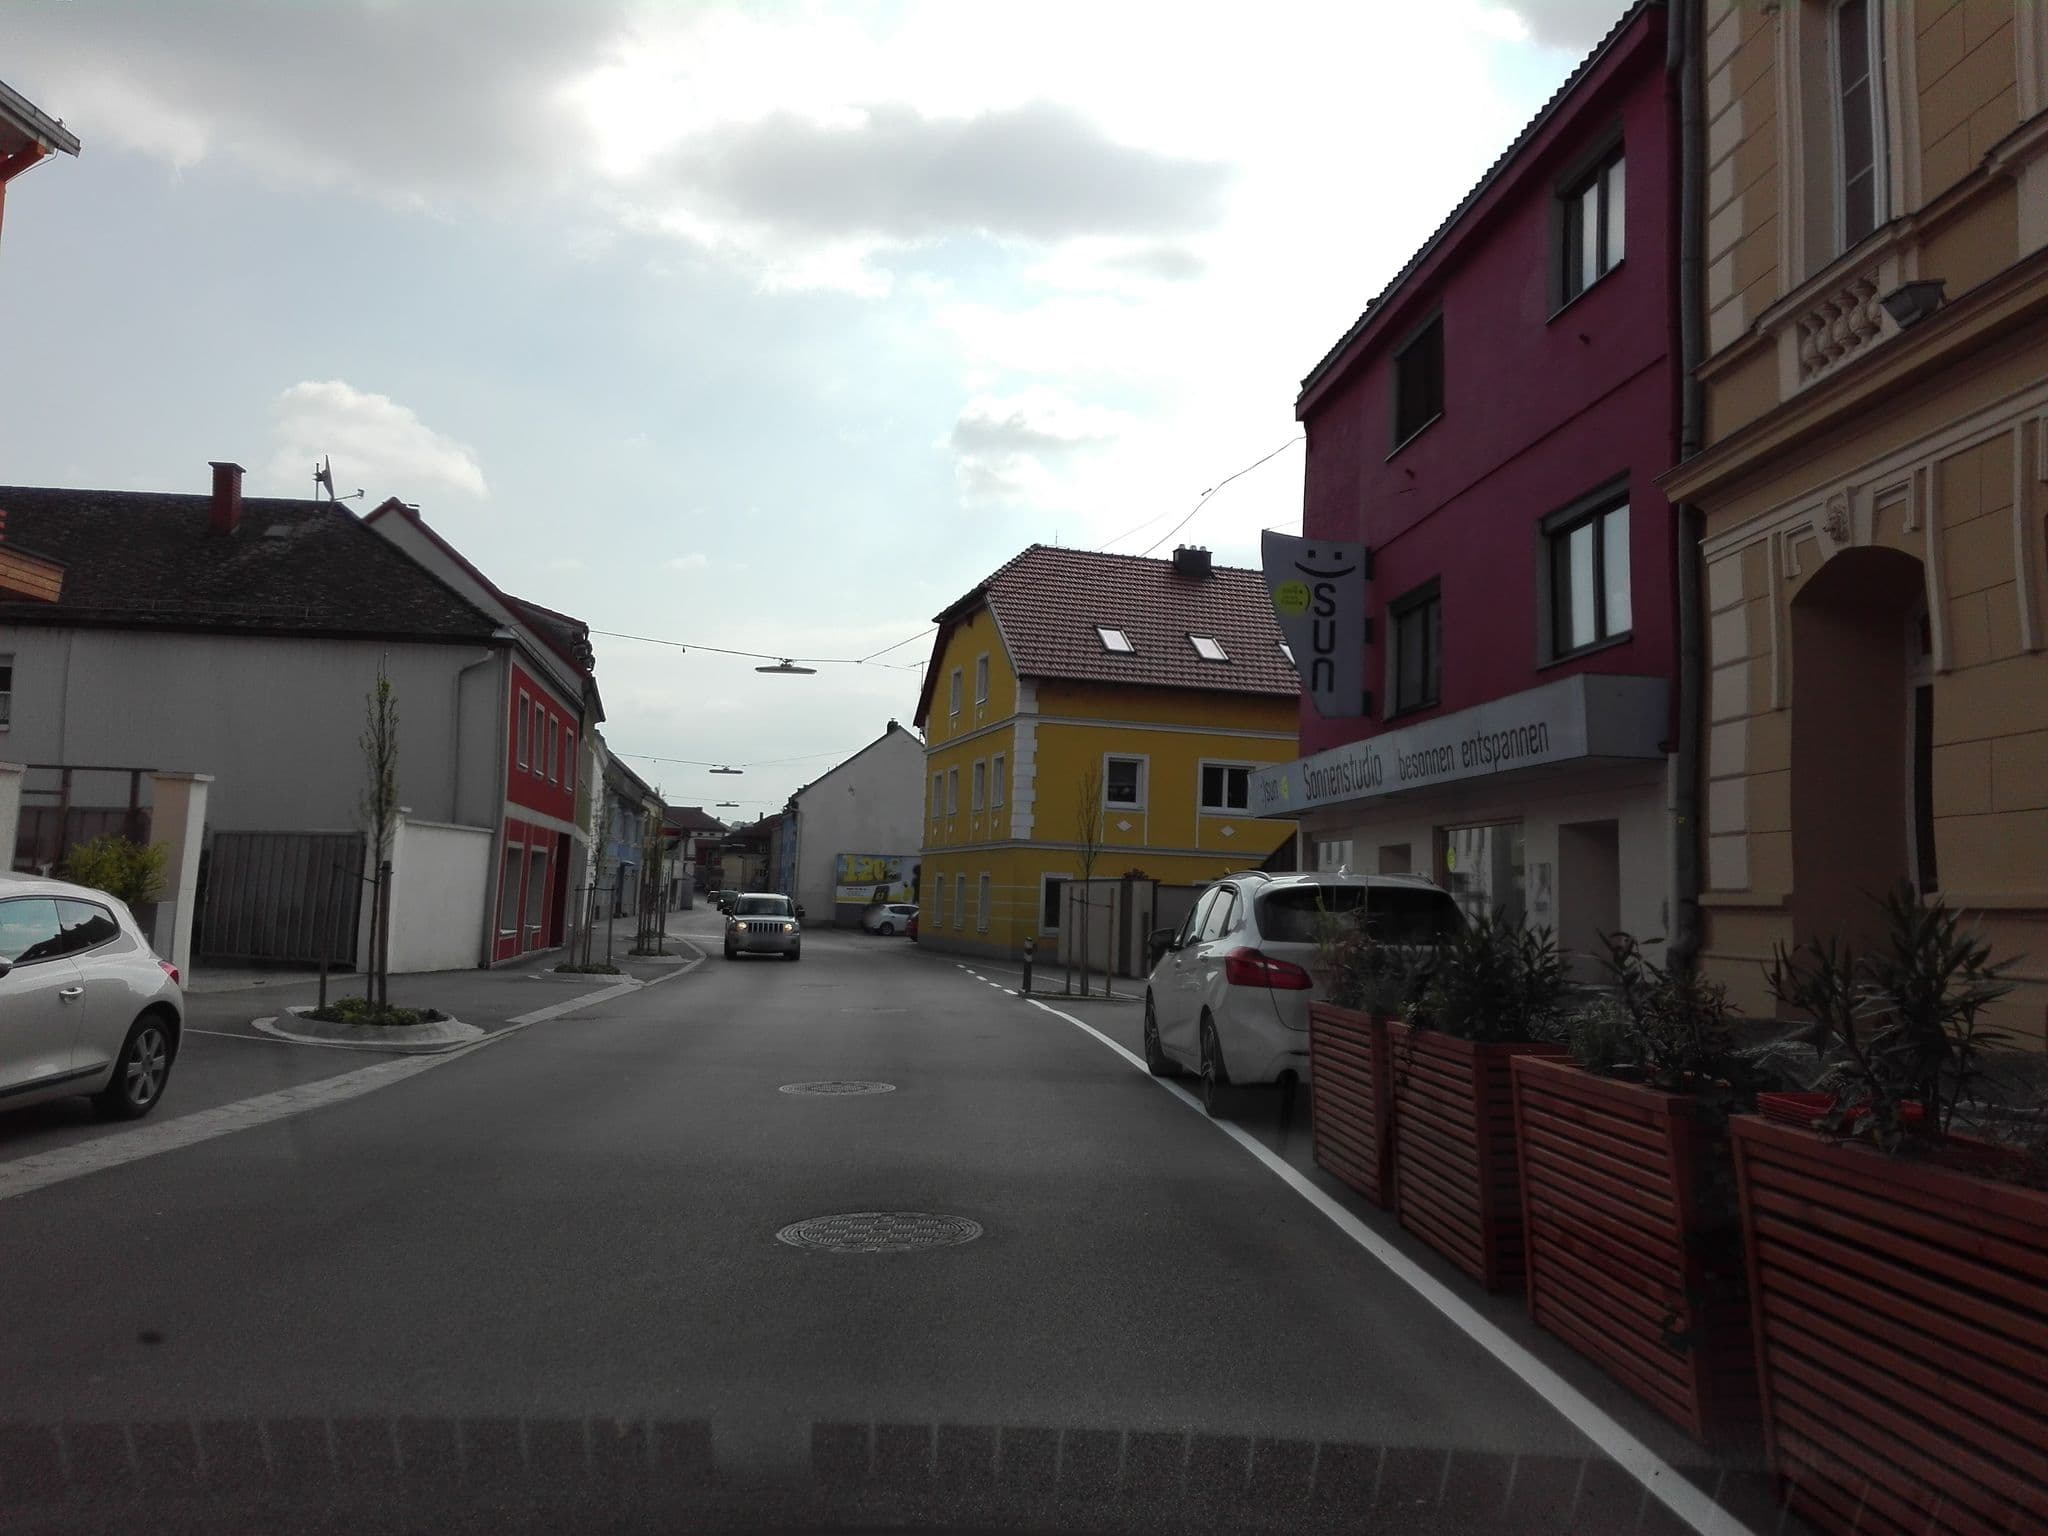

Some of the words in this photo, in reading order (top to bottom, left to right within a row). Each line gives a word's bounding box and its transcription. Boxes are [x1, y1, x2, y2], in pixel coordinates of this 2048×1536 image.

[1303, 744, 1383, 800] Sonnenstudio
[1399, 744, 1455, 781] besonnen
[1461, 721, 1549, 774] entspannen
